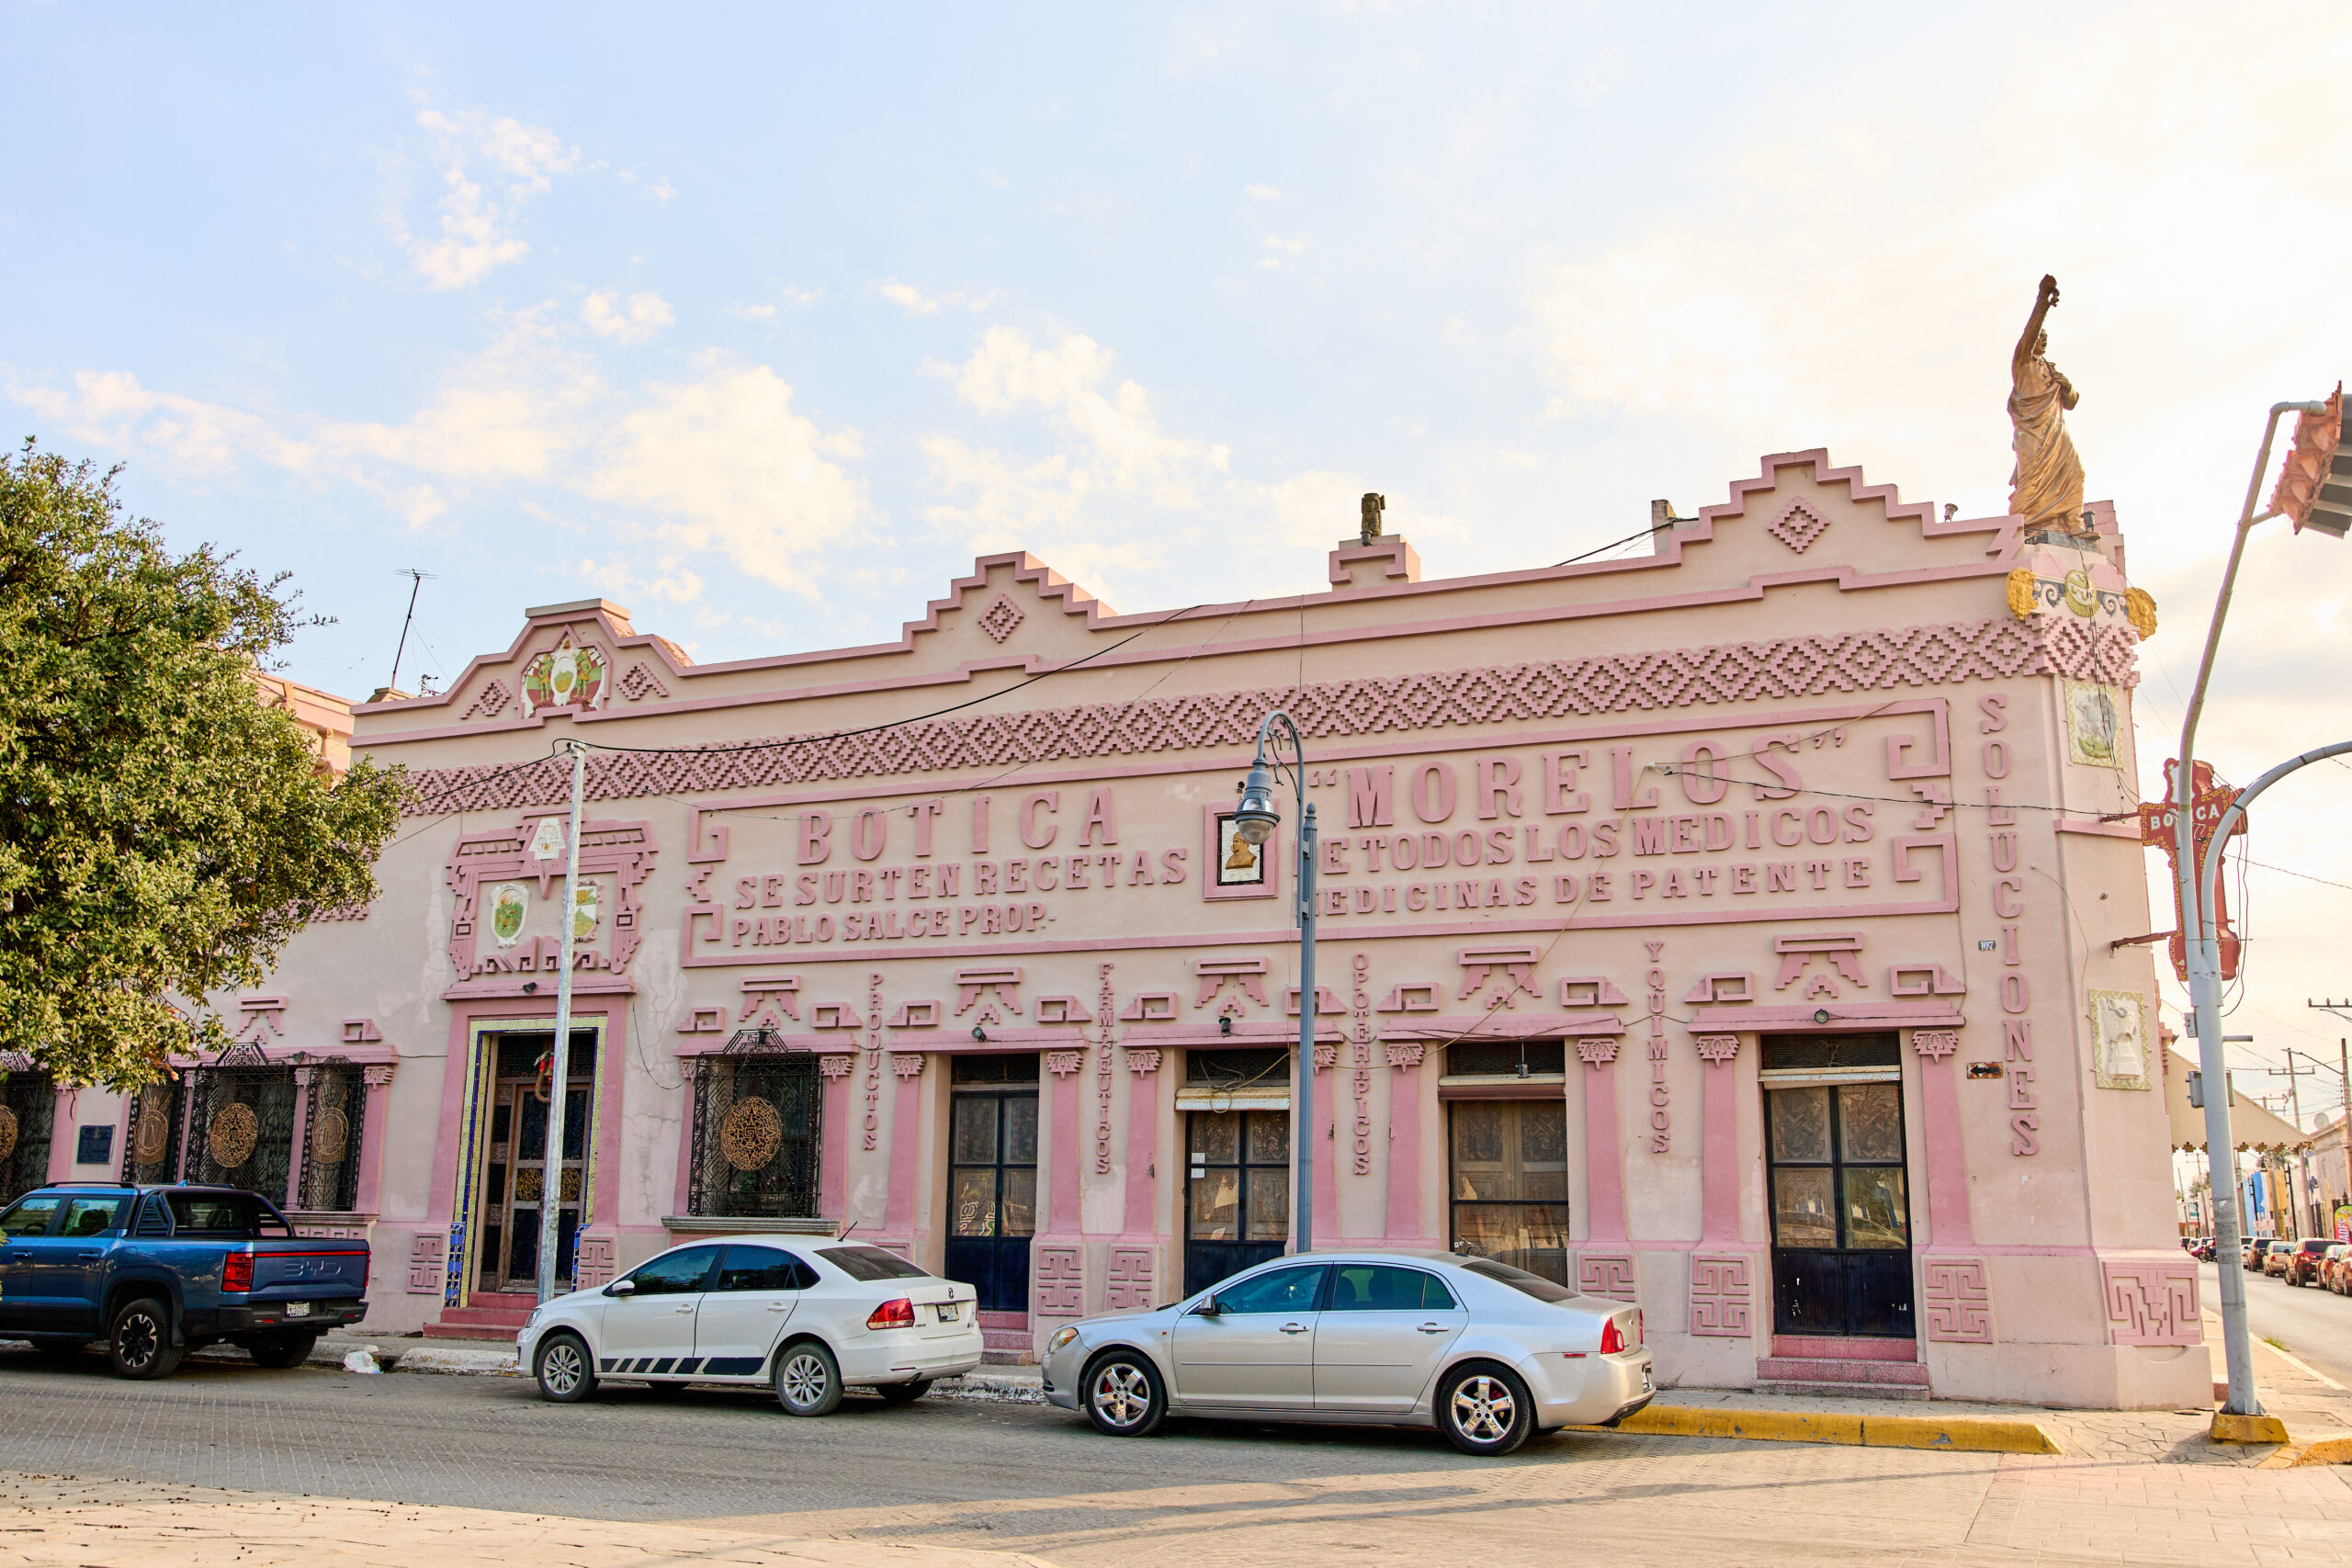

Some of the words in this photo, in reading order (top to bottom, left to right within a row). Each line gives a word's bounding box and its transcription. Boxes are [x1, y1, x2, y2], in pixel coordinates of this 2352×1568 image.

[797, 785, 1118, 865] BOTICA
[1360, 827, 1514, 872] TODOS
[1525, 819, 1621, 862] LOS
[1634, 802, 1875, 856] MEDICOS
[2150, 804, 2221, 830] BOCA
[735, 874, 783, 909] SE
[794, 863, 961, 906] SURTEN
[974, 849, 1188, 894] RECETAS
[1555, 873, 1612, 904] DE
[1632, 857, 1871, 899] PATENTE
[732, 914, 835, 946] PABLO
[842, 907, 950, 941] SALCE
[1645, 941, 1664, 962] Y
[1979, 694, 2039, 1156] SOLUCIONES
[864, 972, 884, 1151] PRODUCTOS
[1095, 963, 1114, 1174] FARMACEUTICOS
[1353, 953, 1370, 1176] OPOTERAPICOS
[1647, 967, 1669, 1153] QUIMICOS
